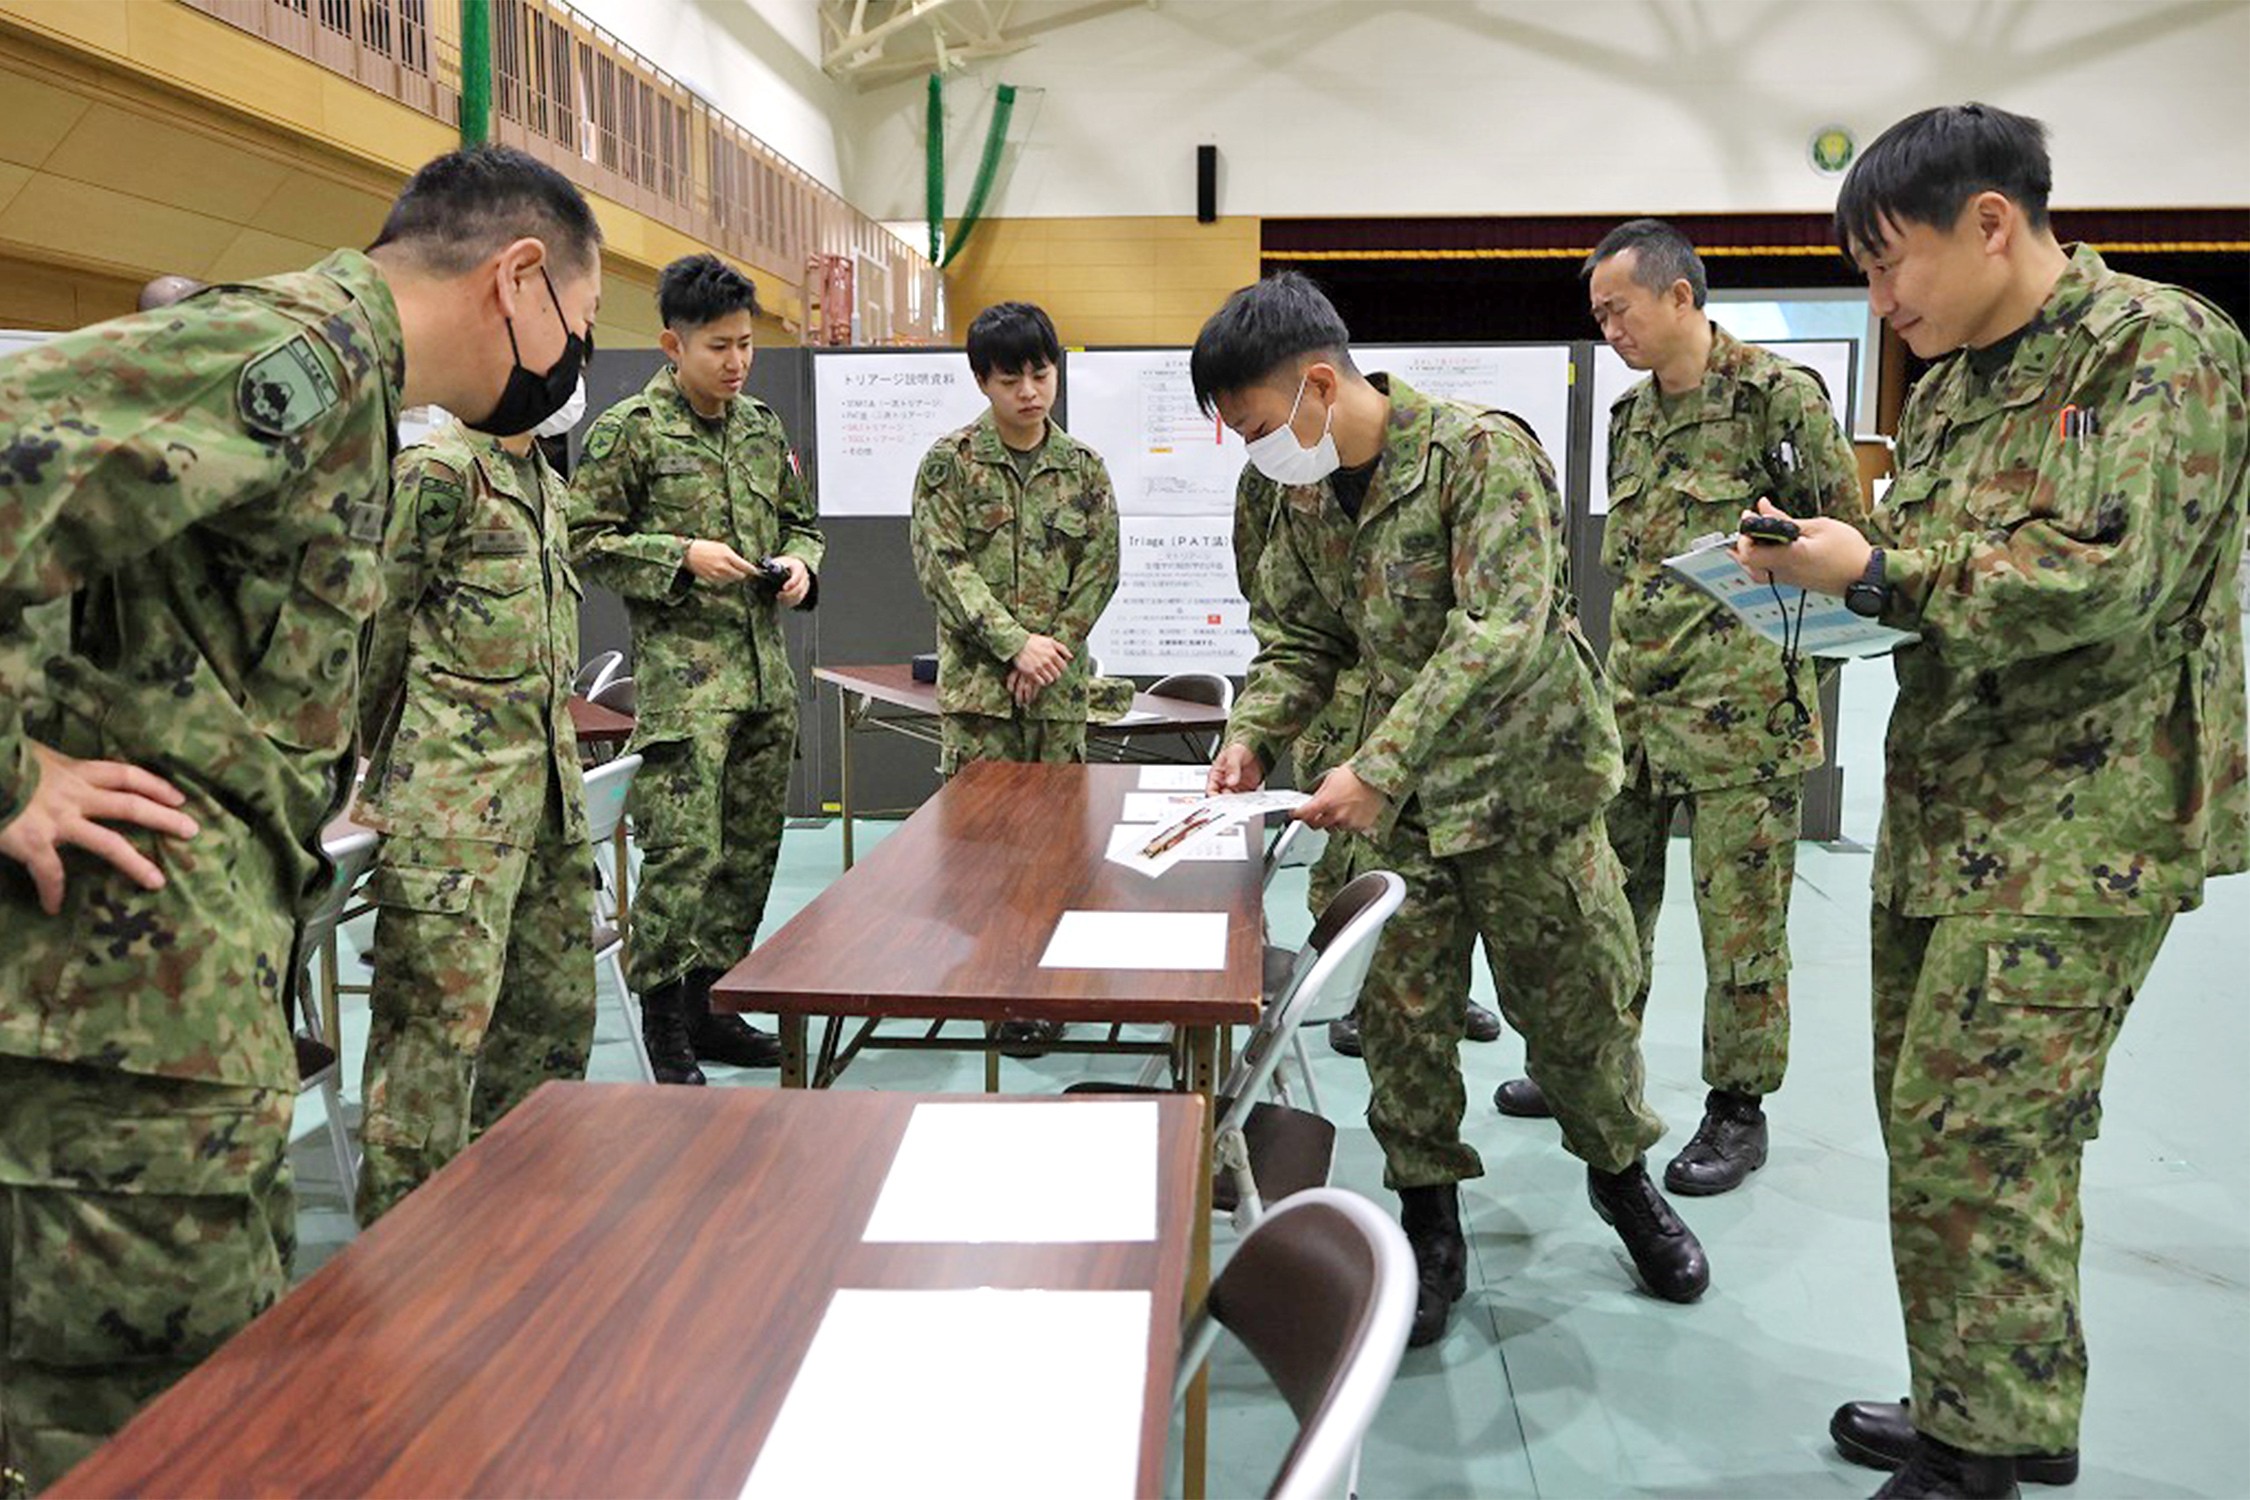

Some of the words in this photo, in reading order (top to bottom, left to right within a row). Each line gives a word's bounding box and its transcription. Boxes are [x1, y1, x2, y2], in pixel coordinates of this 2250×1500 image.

[844, 372, 956, 386] トリアージ説明資料
[1128, 535, 1164, 548] Triage
